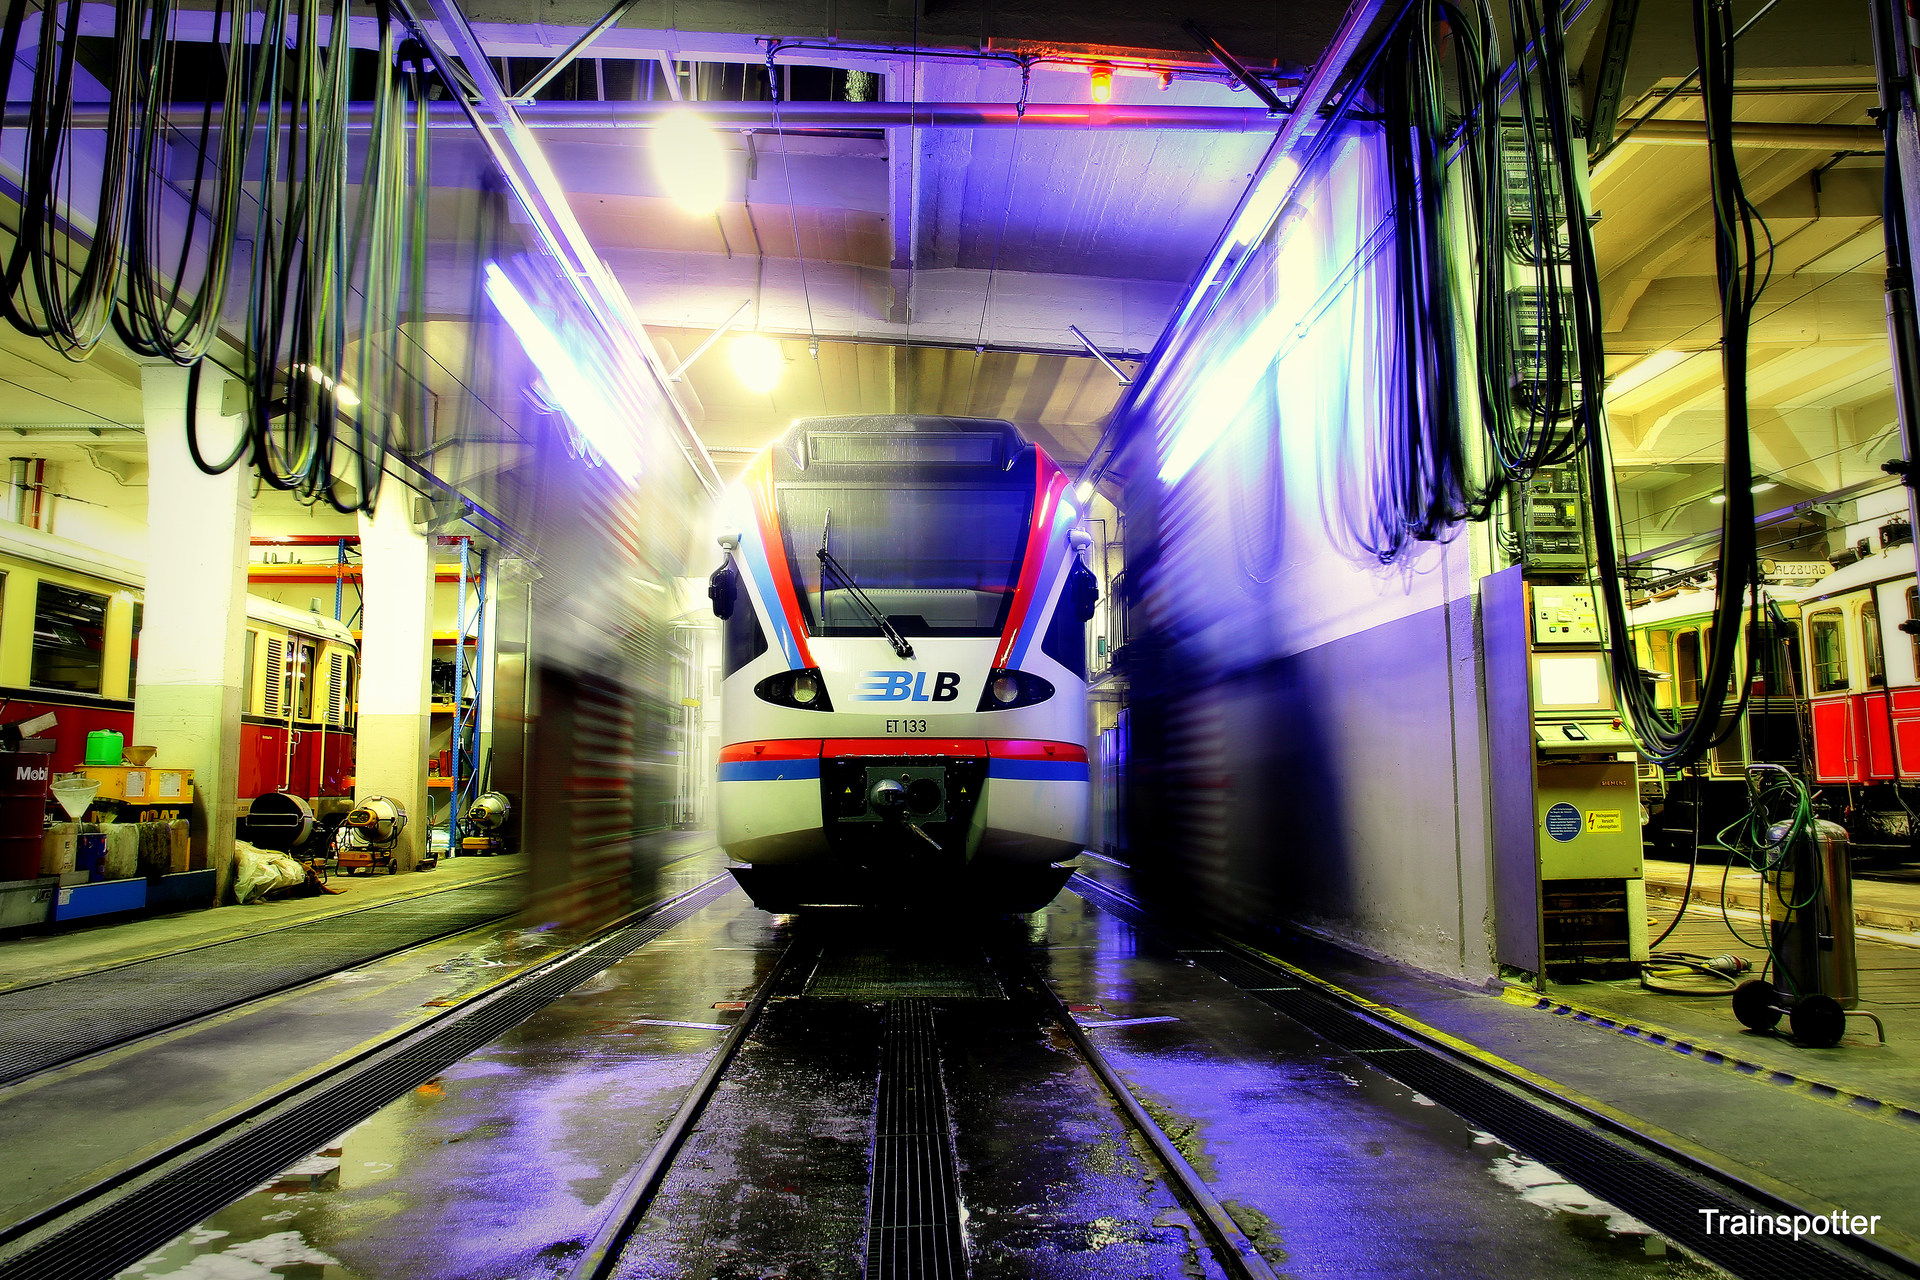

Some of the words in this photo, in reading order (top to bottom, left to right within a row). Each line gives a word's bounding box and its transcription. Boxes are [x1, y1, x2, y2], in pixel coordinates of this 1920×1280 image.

[1775, 564, 1826, 575] ALZBURG
[856, 671, 960, 702] BLB
[886, 720, 899, 733] ET
[903, 720, 927, 733] 133
